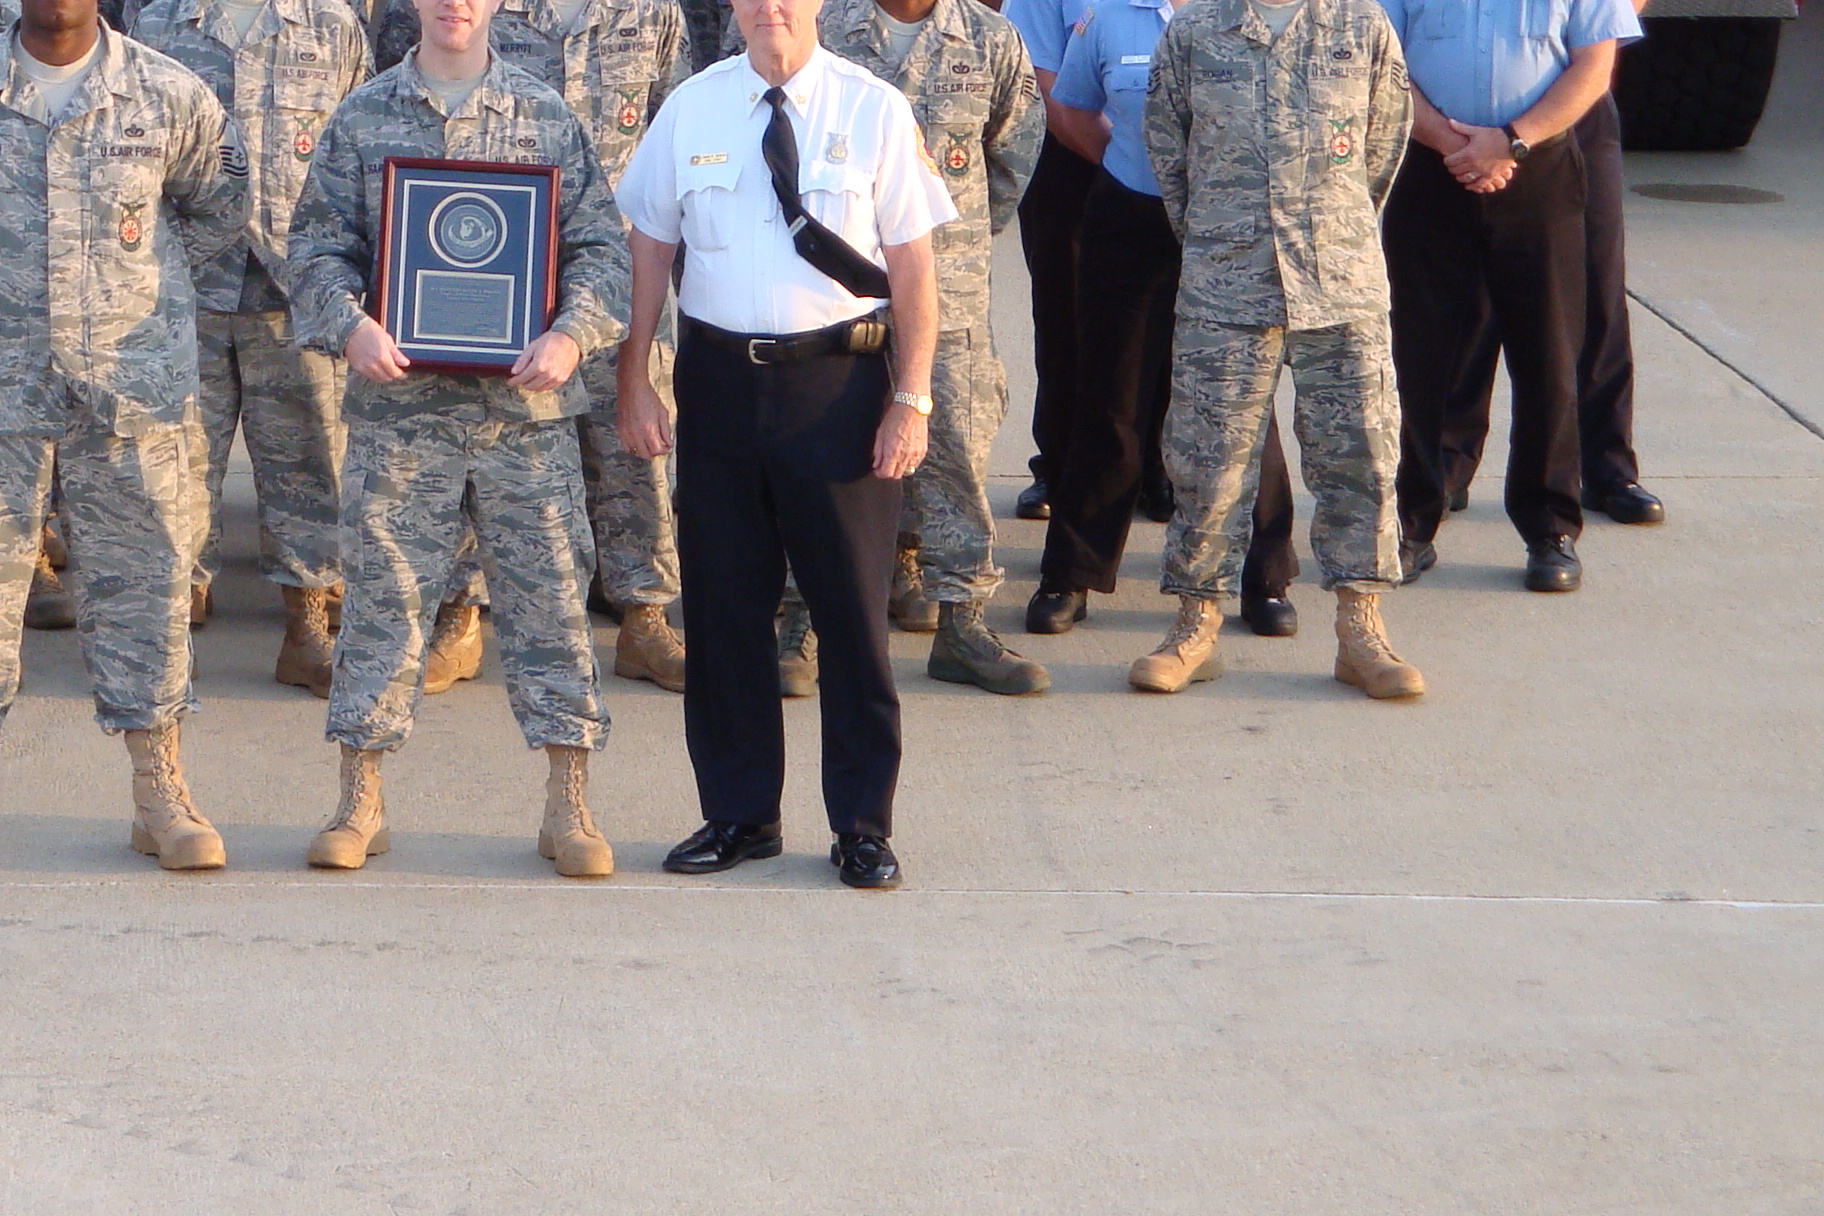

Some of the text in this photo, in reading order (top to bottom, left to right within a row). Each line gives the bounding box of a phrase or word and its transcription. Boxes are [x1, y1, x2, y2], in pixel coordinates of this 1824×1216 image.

[950, 83, 964, 93] AIR
[118, 146, 133, 157] AIR
[135, 147, 162, 158] FORCE
